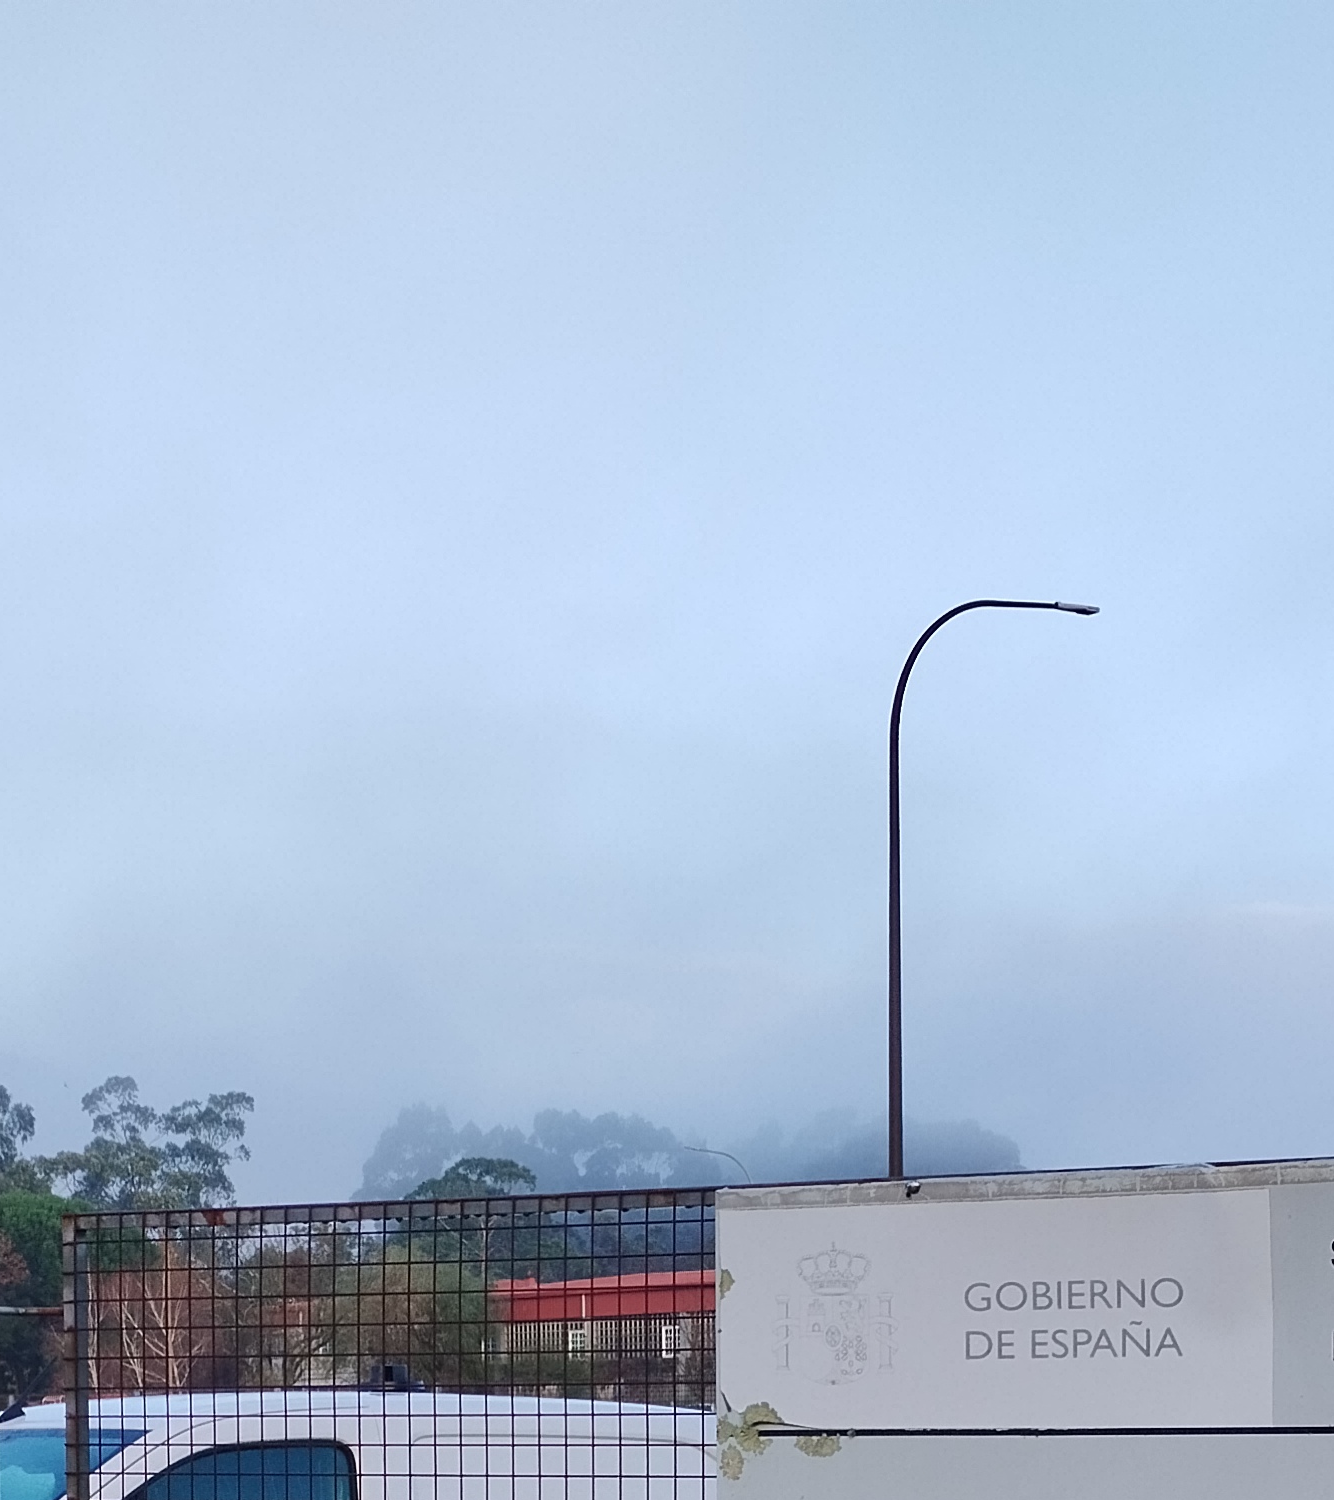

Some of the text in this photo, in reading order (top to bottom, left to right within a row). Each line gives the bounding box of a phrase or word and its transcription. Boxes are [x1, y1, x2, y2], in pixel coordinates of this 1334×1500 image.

[964, 1277, 1184, 1312] GOBIERNO
[965, 1320, 1183, 1361] DE ESPAÑA
